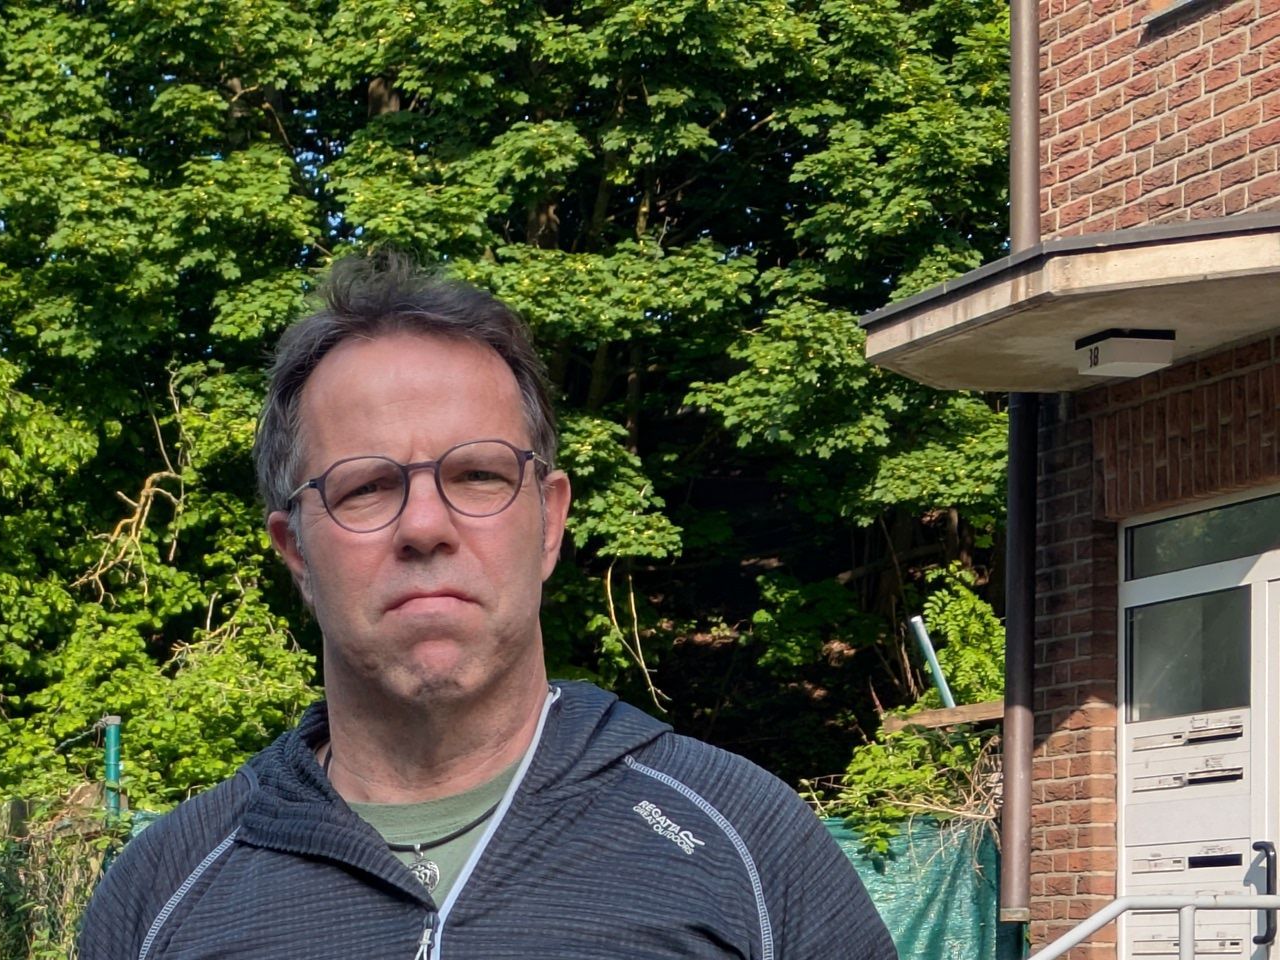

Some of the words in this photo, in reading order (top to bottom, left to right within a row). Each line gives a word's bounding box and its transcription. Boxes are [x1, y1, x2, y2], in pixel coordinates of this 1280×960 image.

[632, 805, 657, 825] GREAT
[653, 823, 695, 855] OUTDOORS
[638, 800, 681, 834] REGATTA
